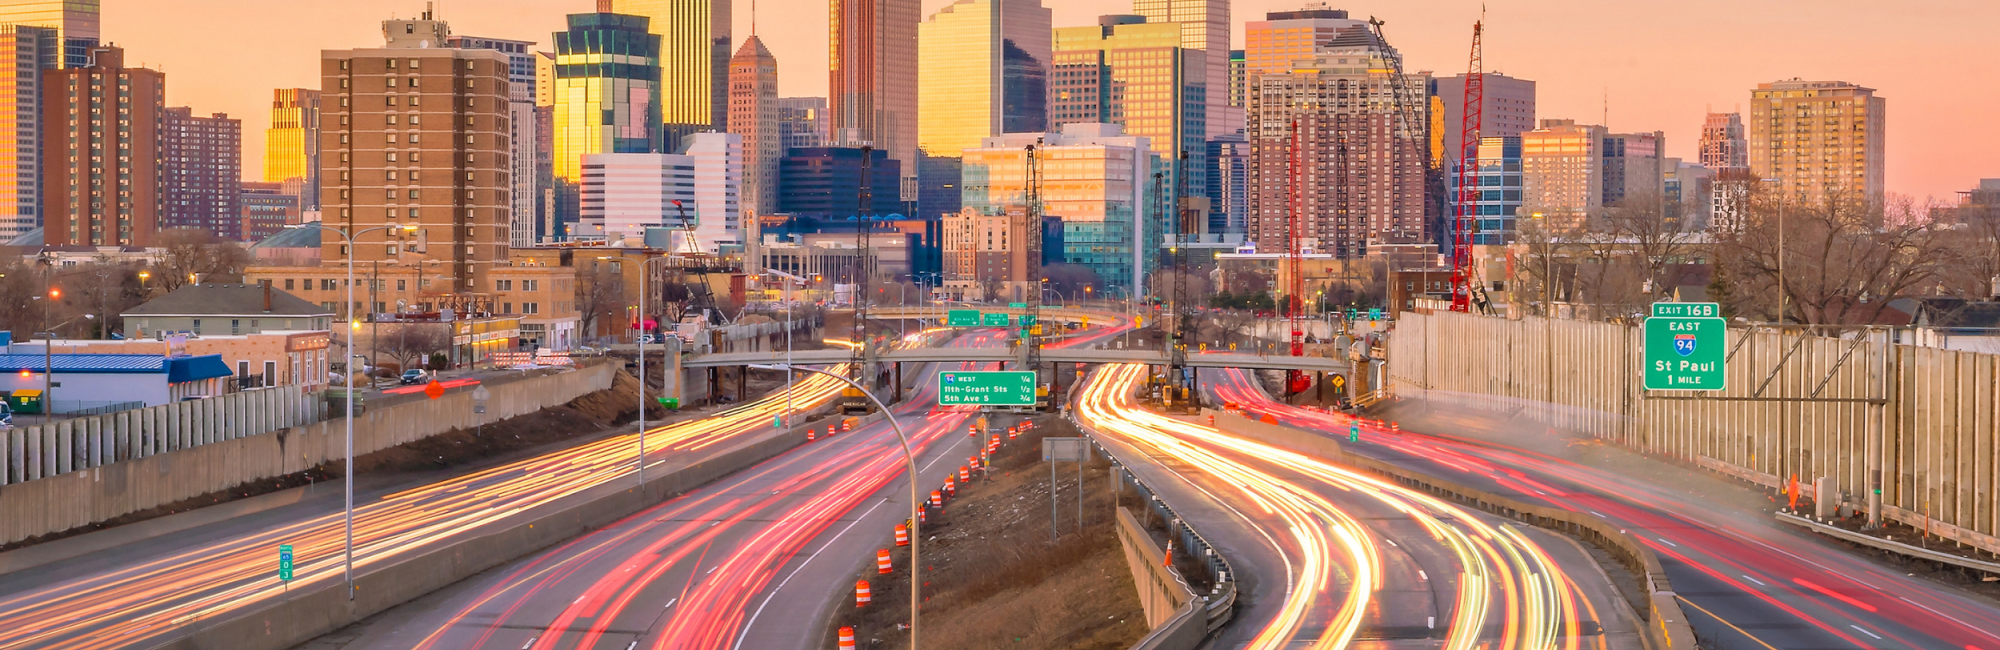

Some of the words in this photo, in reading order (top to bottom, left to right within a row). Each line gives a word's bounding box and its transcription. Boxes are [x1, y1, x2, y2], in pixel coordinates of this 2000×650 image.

[1687, 305, 1712, 316] 16B
[1669, 322, 1700, 330] EAST
[1676, 340, 1693, 350] 94
[1655, 360, 1672, 372] St
[1680, 360, 1714, 372] Paul
[1668, 374, 1672, 385] 1
